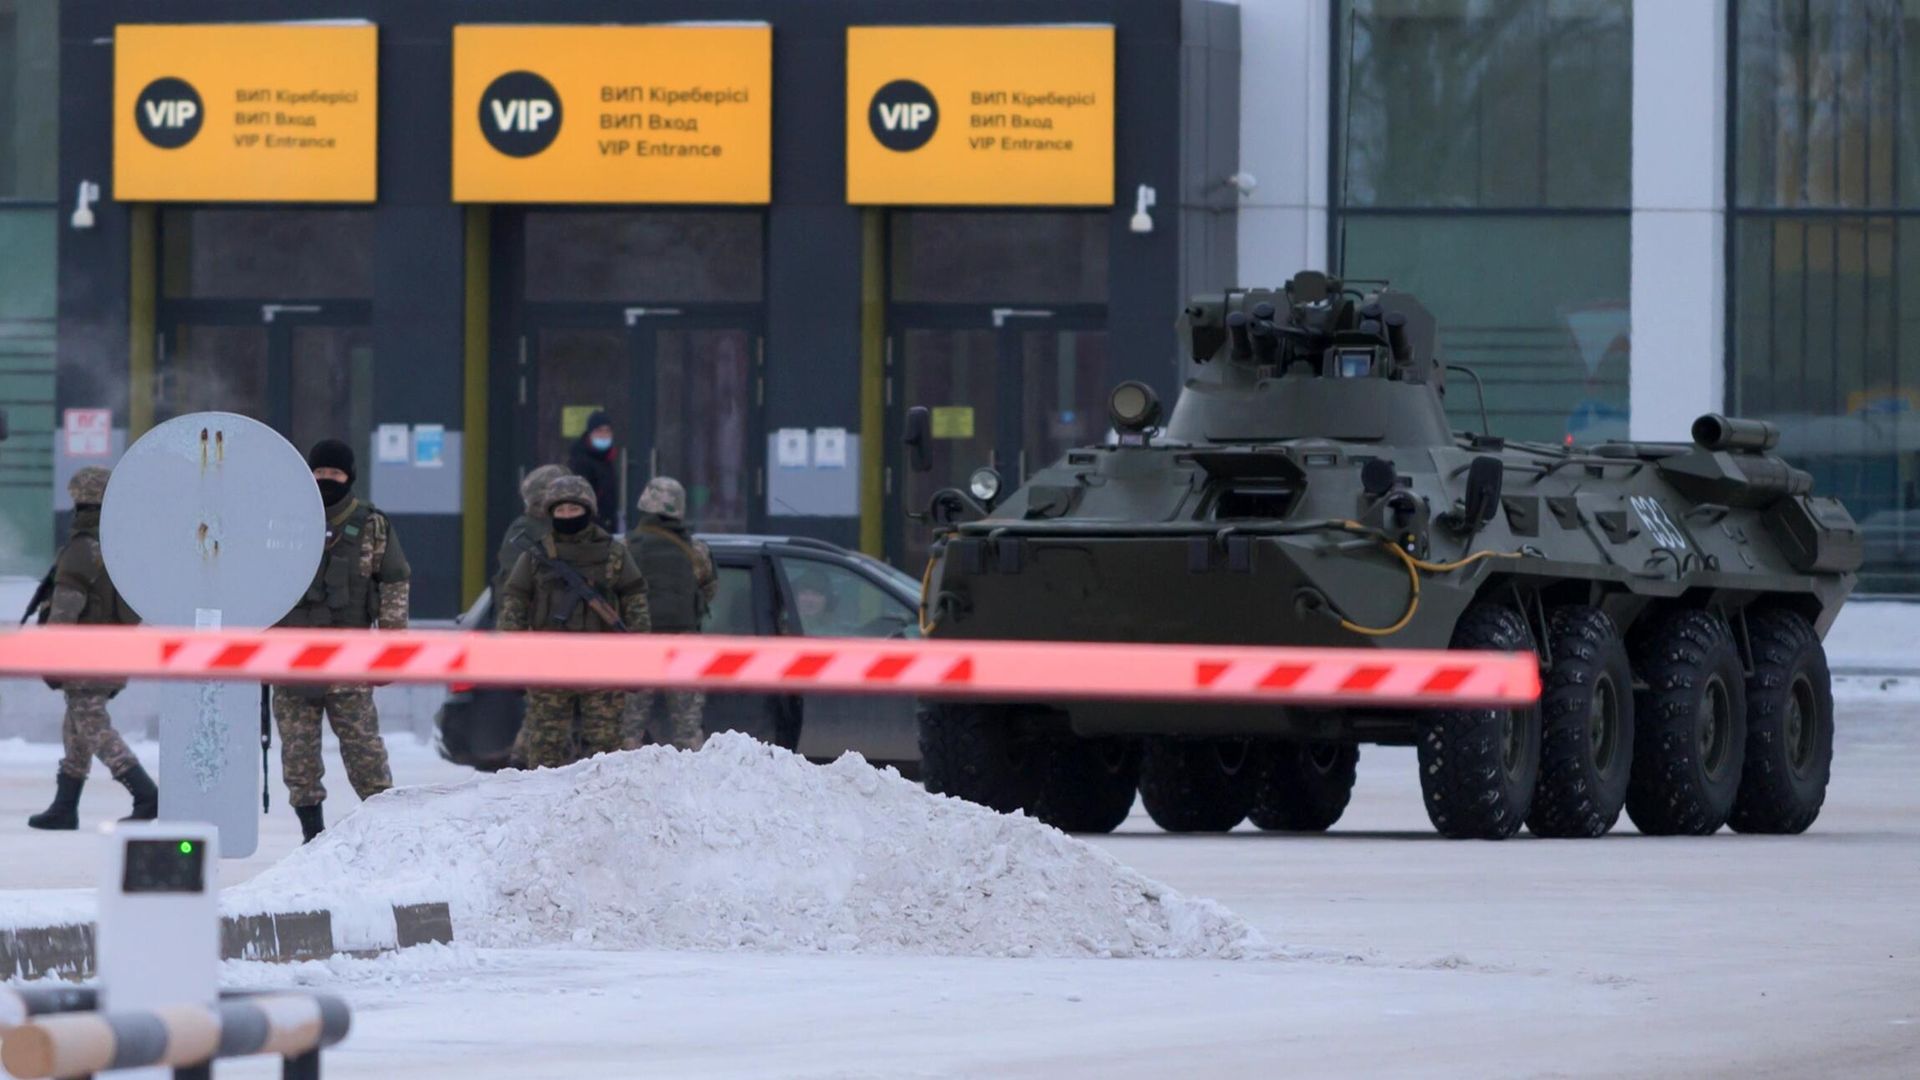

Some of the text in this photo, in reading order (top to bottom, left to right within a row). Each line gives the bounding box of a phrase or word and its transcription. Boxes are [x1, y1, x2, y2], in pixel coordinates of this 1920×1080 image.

[236, 89, 359, 105] ВИП Кіреберісі
[600, 86, 749, 105] ВИП Кіреберісі
[971, 91, 1096, 107] ВИП Кіреберісі
[144, 100, 197, 127] VIP
[235, 112, 316, 127] ВИП Вход
[491, 99, 553, 131] VIP
[878, 103, 932, 130] VIP
[970, 114, 1053, 130] ВИП Вход
[599, 114, 698, 132] ВИП Вход
[234, 134, 336, 148] VIP Entrance
[598, 140, 722, 157] VIP Entrance
[968, 137, 1073, 151] VIP Entrance
[1629, 495, 1686, 549] 633
